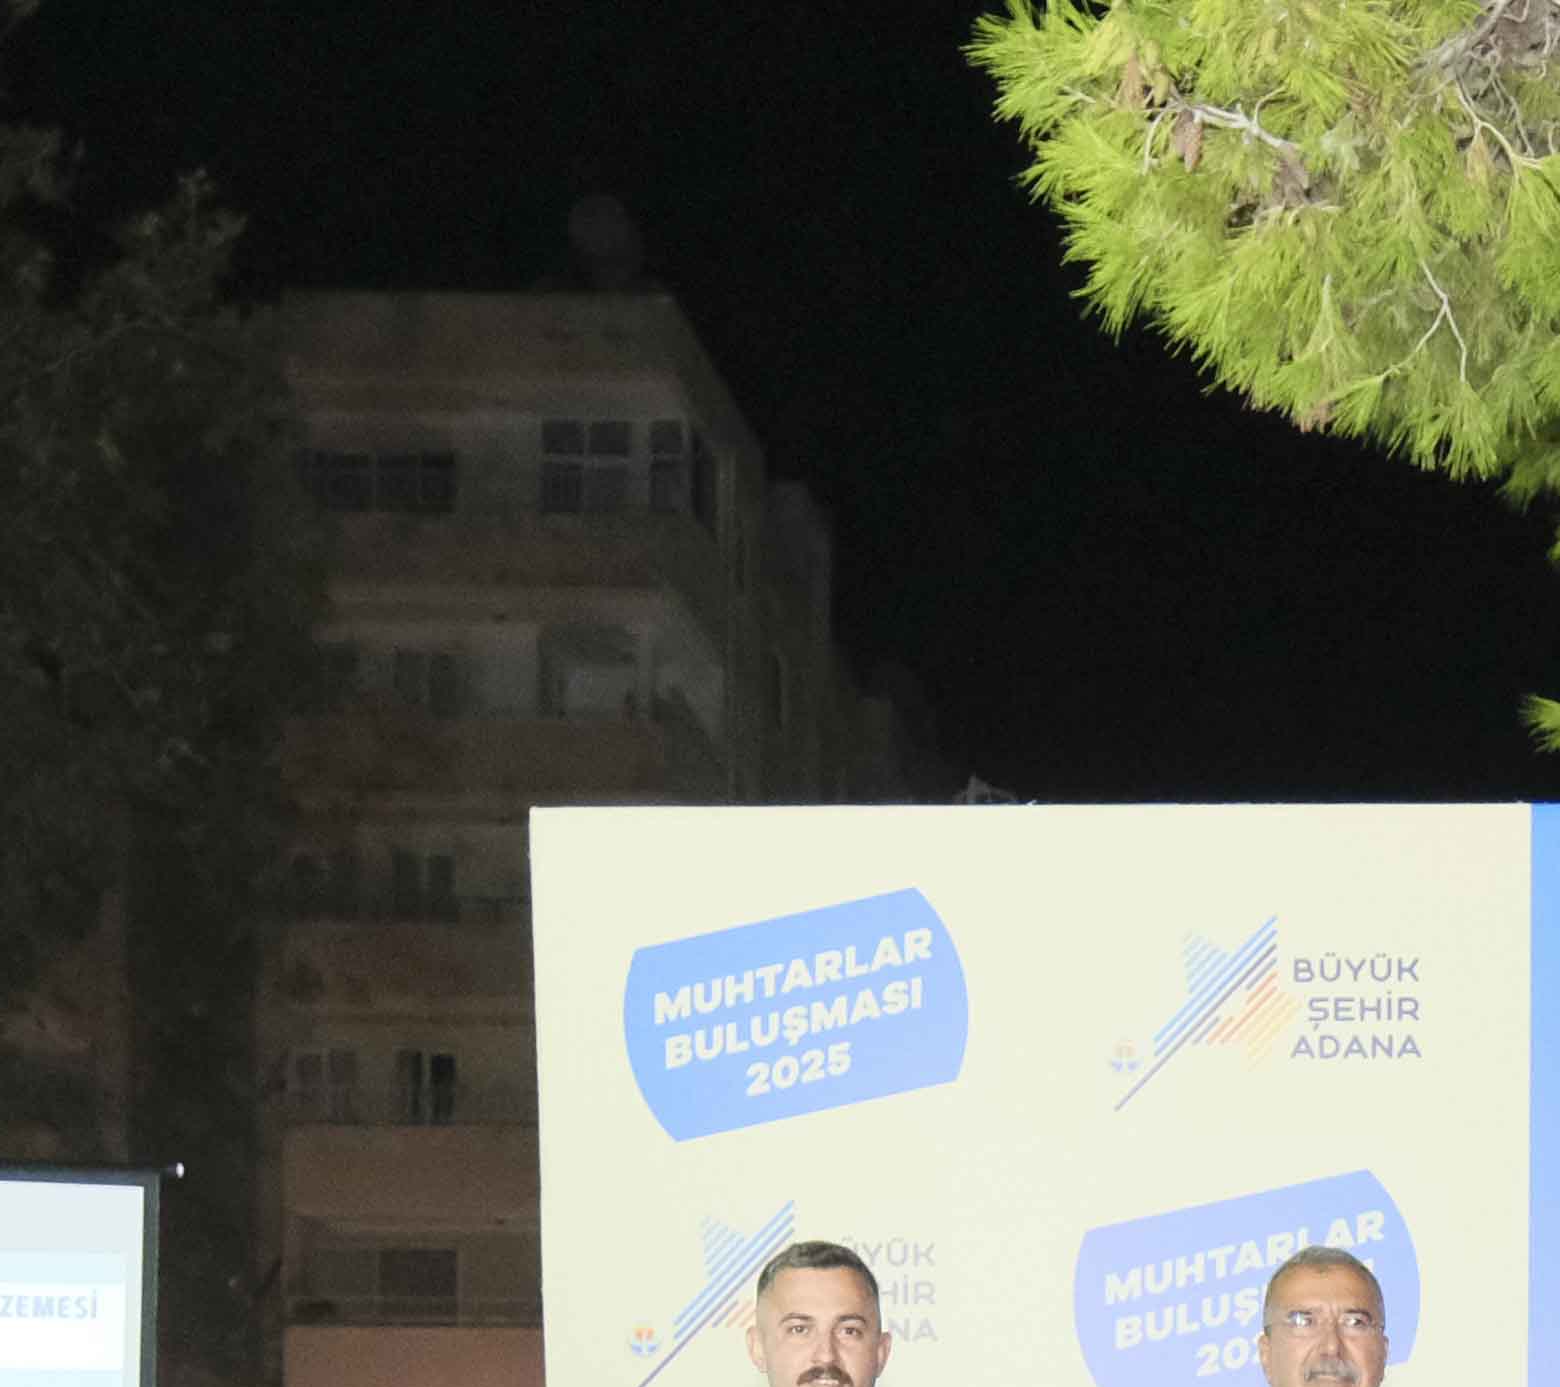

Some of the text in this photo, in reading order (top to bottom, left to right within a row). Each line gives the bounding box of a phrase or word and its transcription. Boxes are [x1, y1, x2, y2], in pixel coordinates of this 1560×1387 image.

[654, 928, 932, 1024] MUHTARLAR
[1293, 952, 1419, 982] BÜYÜK
[665, 977, 922, 1069] BULUŞMASI
[1308, 990, 1419, 1031] ŞEHİR
[1290, 1035, 1422, 1059] ADANA
[746, 1042, 851, 1096] 2025
[842, 1236, 937, 1267] YÜK
